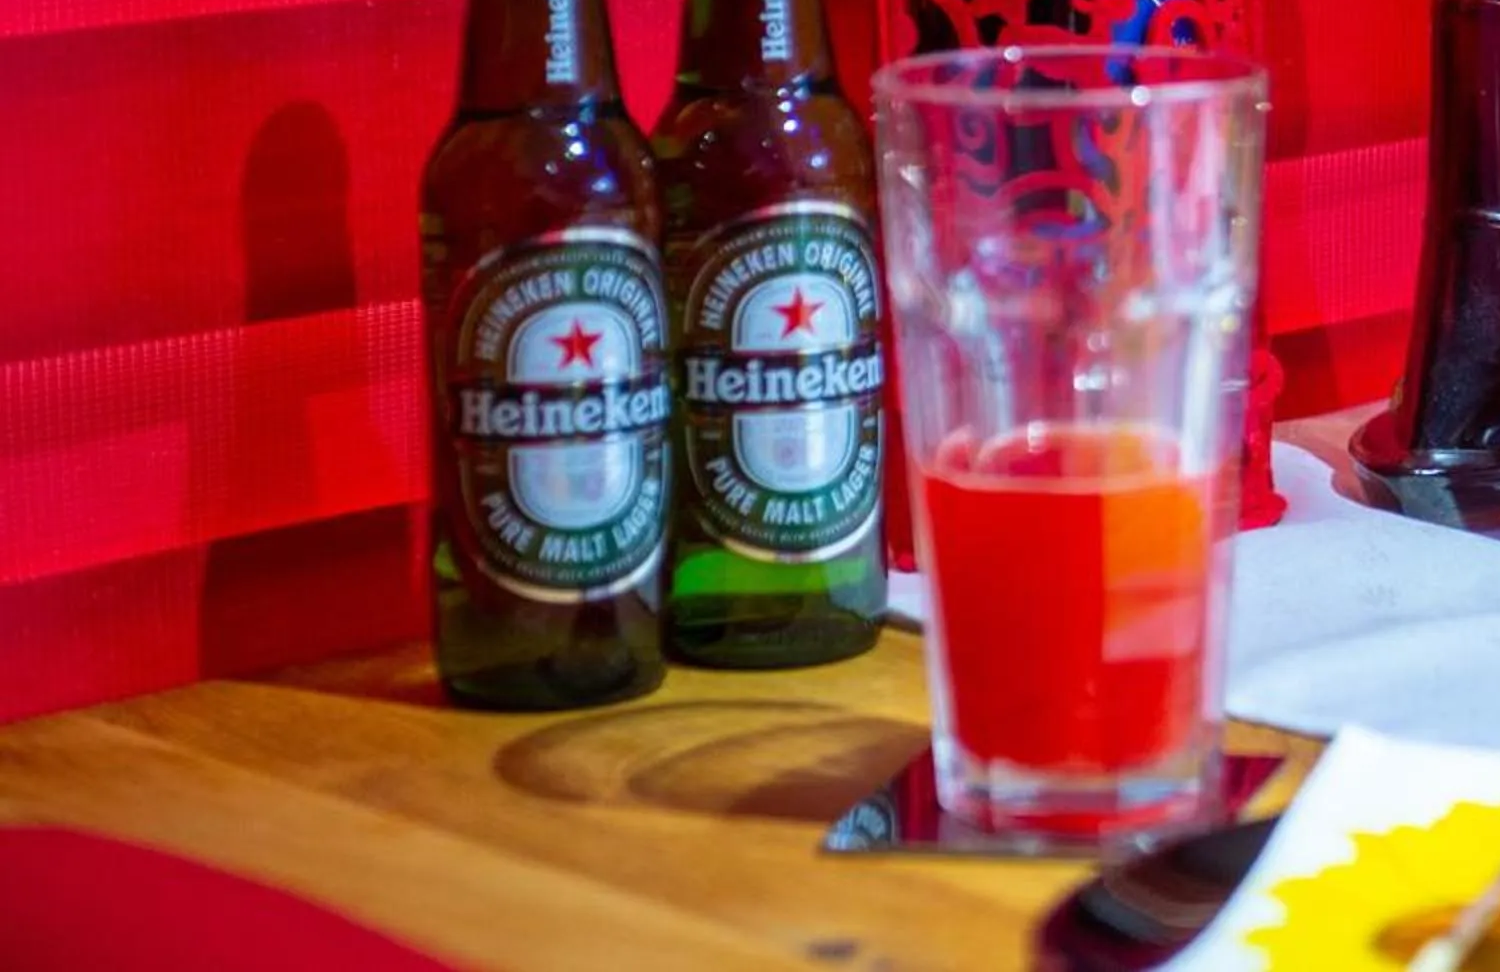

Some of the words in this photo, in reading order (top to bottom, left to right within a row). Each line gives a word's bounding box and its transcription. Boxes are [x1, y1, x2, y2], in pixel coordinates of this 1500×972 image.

[474, 269, 575, 360] HEINEKEN
[582, 266, 659, 349] ORIGINAL
[701, 242, 796, 330] HEINEKEN
[804, 241, 875, 318] ORIGINAL
[460, 383, 671, 437] Heineken
[685, 354, 884, 404] Heineken
[480, 492, 535, 554] PURE
[537, 531, 607, 563] MALT
[611, 477, 659, 549] LAGER
[706, 455, 758, 517] PURE
[762, 496, 829, 525] MALT
[830, 444, 876, 512] LAGER
